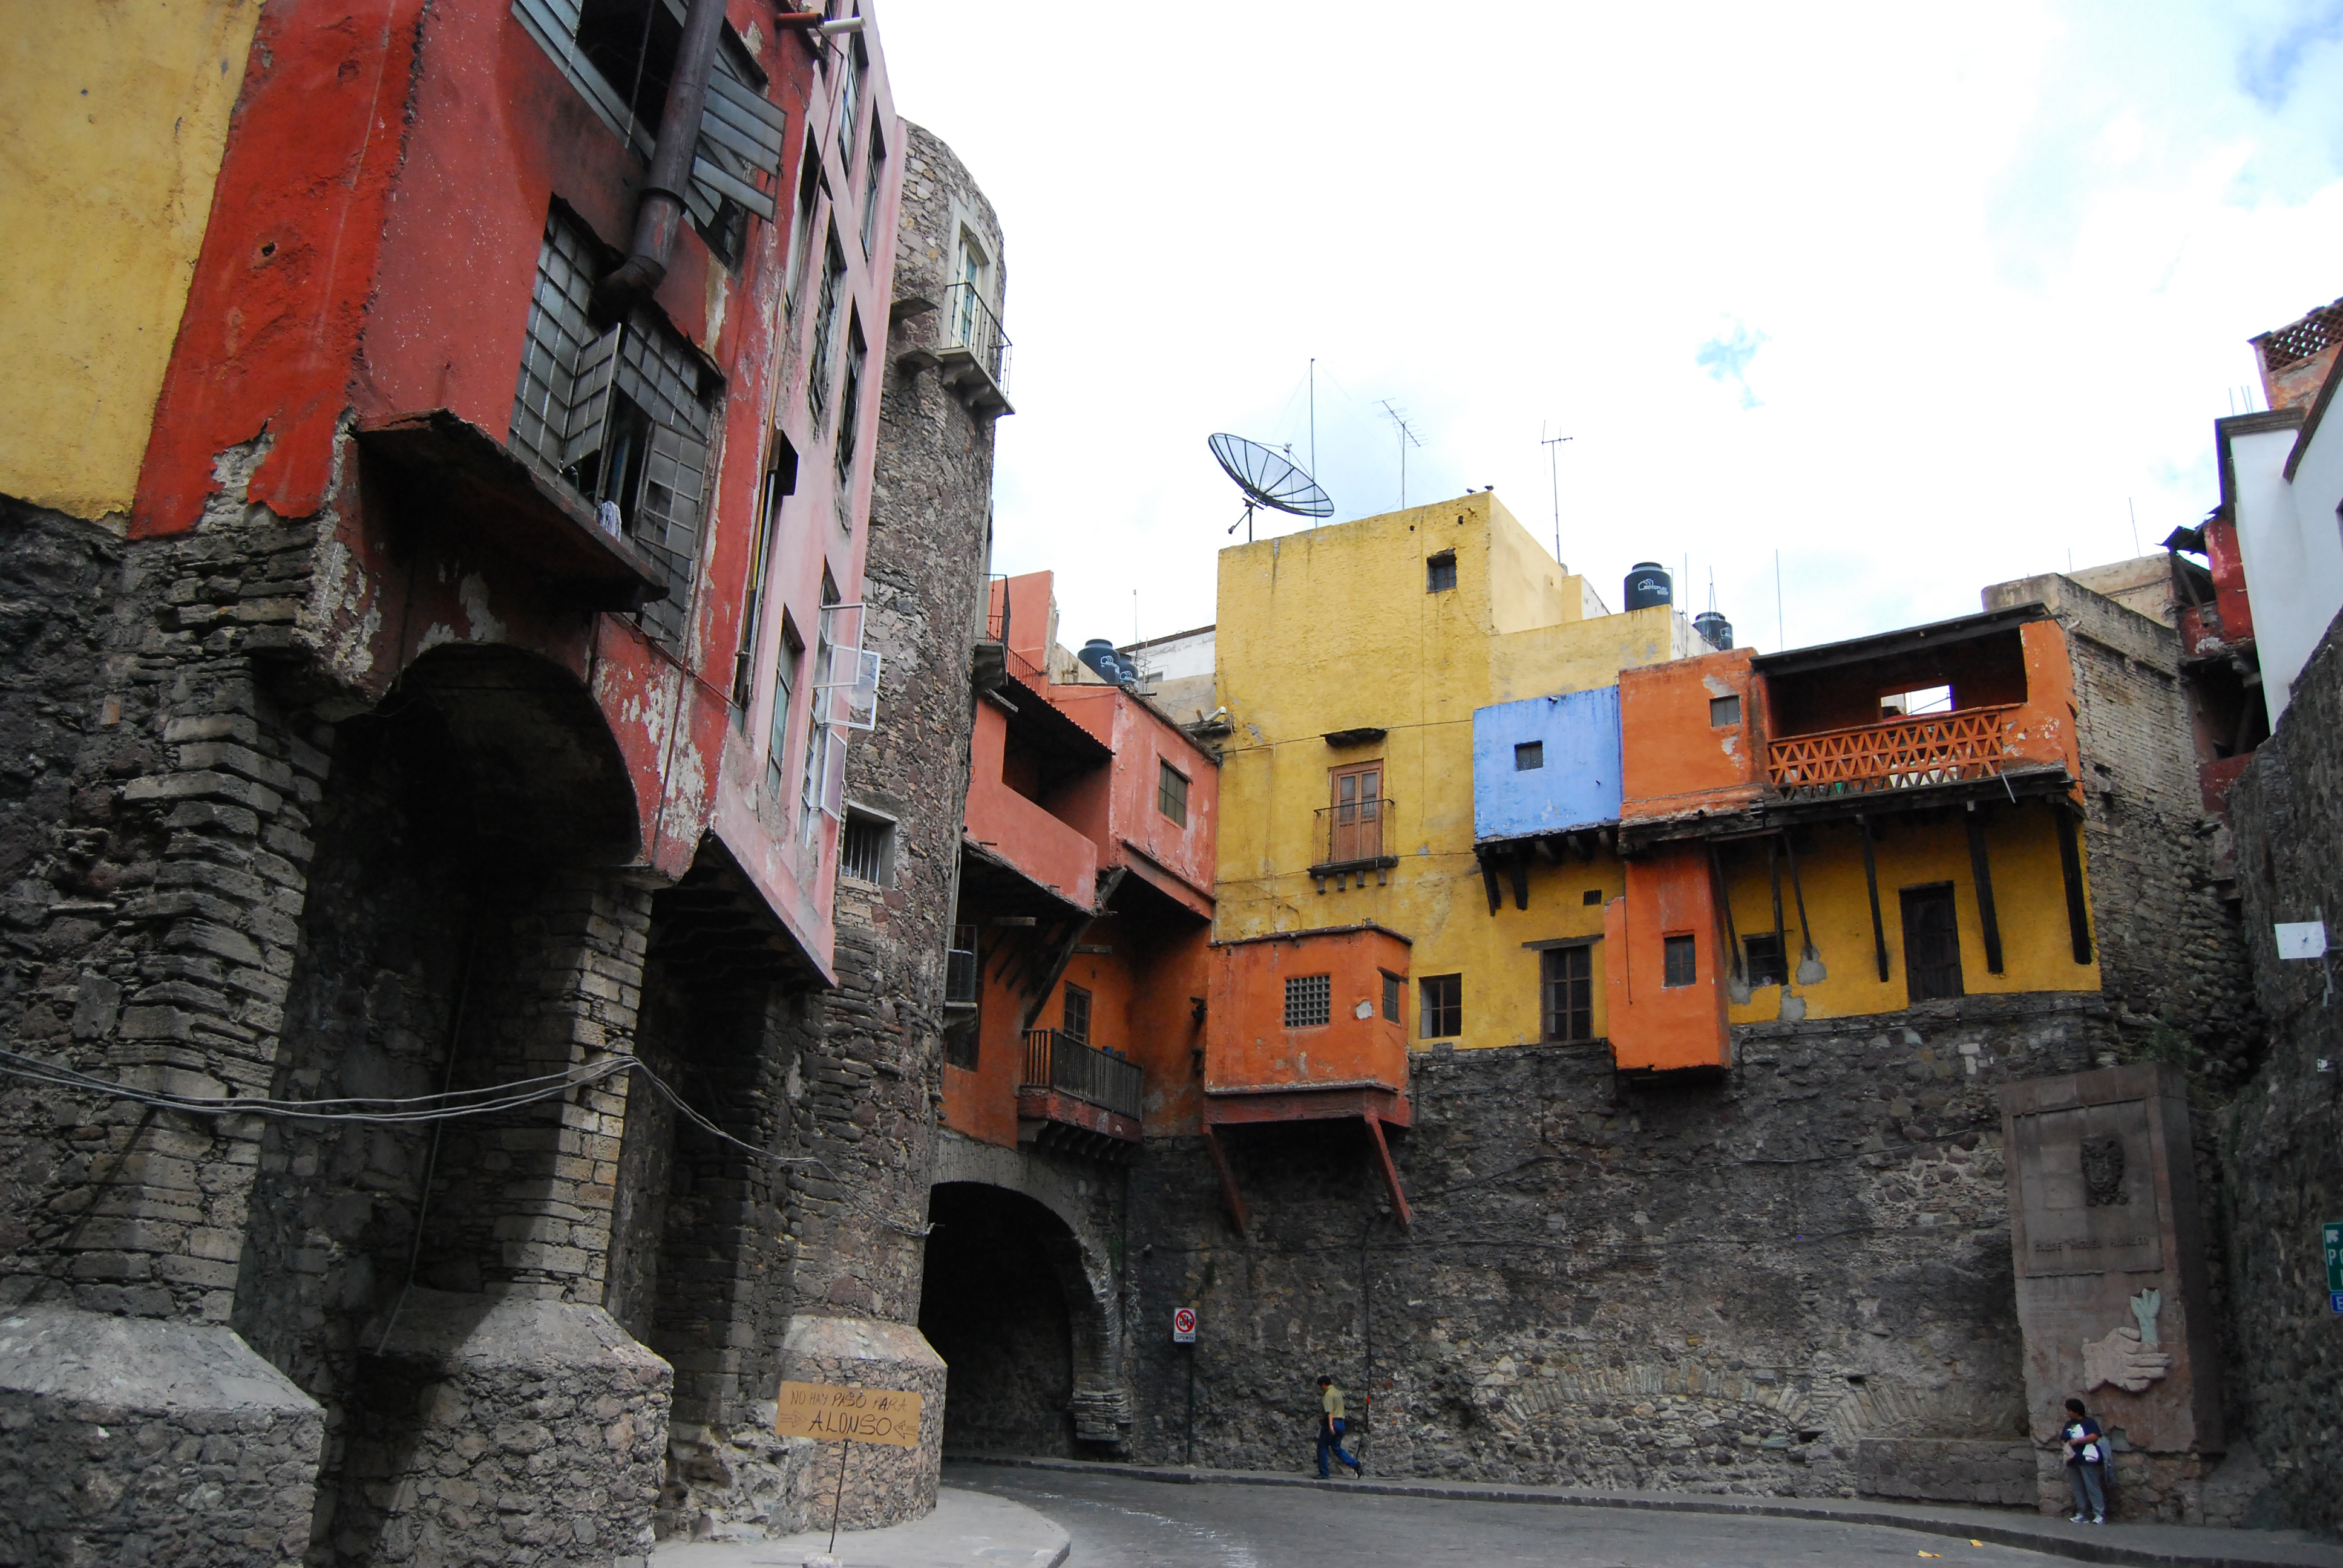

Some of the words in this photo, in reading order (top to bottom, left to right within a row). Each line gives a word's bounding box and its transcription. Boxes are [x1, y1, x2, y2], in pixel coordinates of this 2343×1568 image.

[790, 1390, 806, 1405] NO
[809, 1390, 828, 1405] HAY
[831, 1392, 867, 1408] PASO
[873, 1396, 907, 1412] PARA
[808, 1410, 892, 1436] ALONSO
